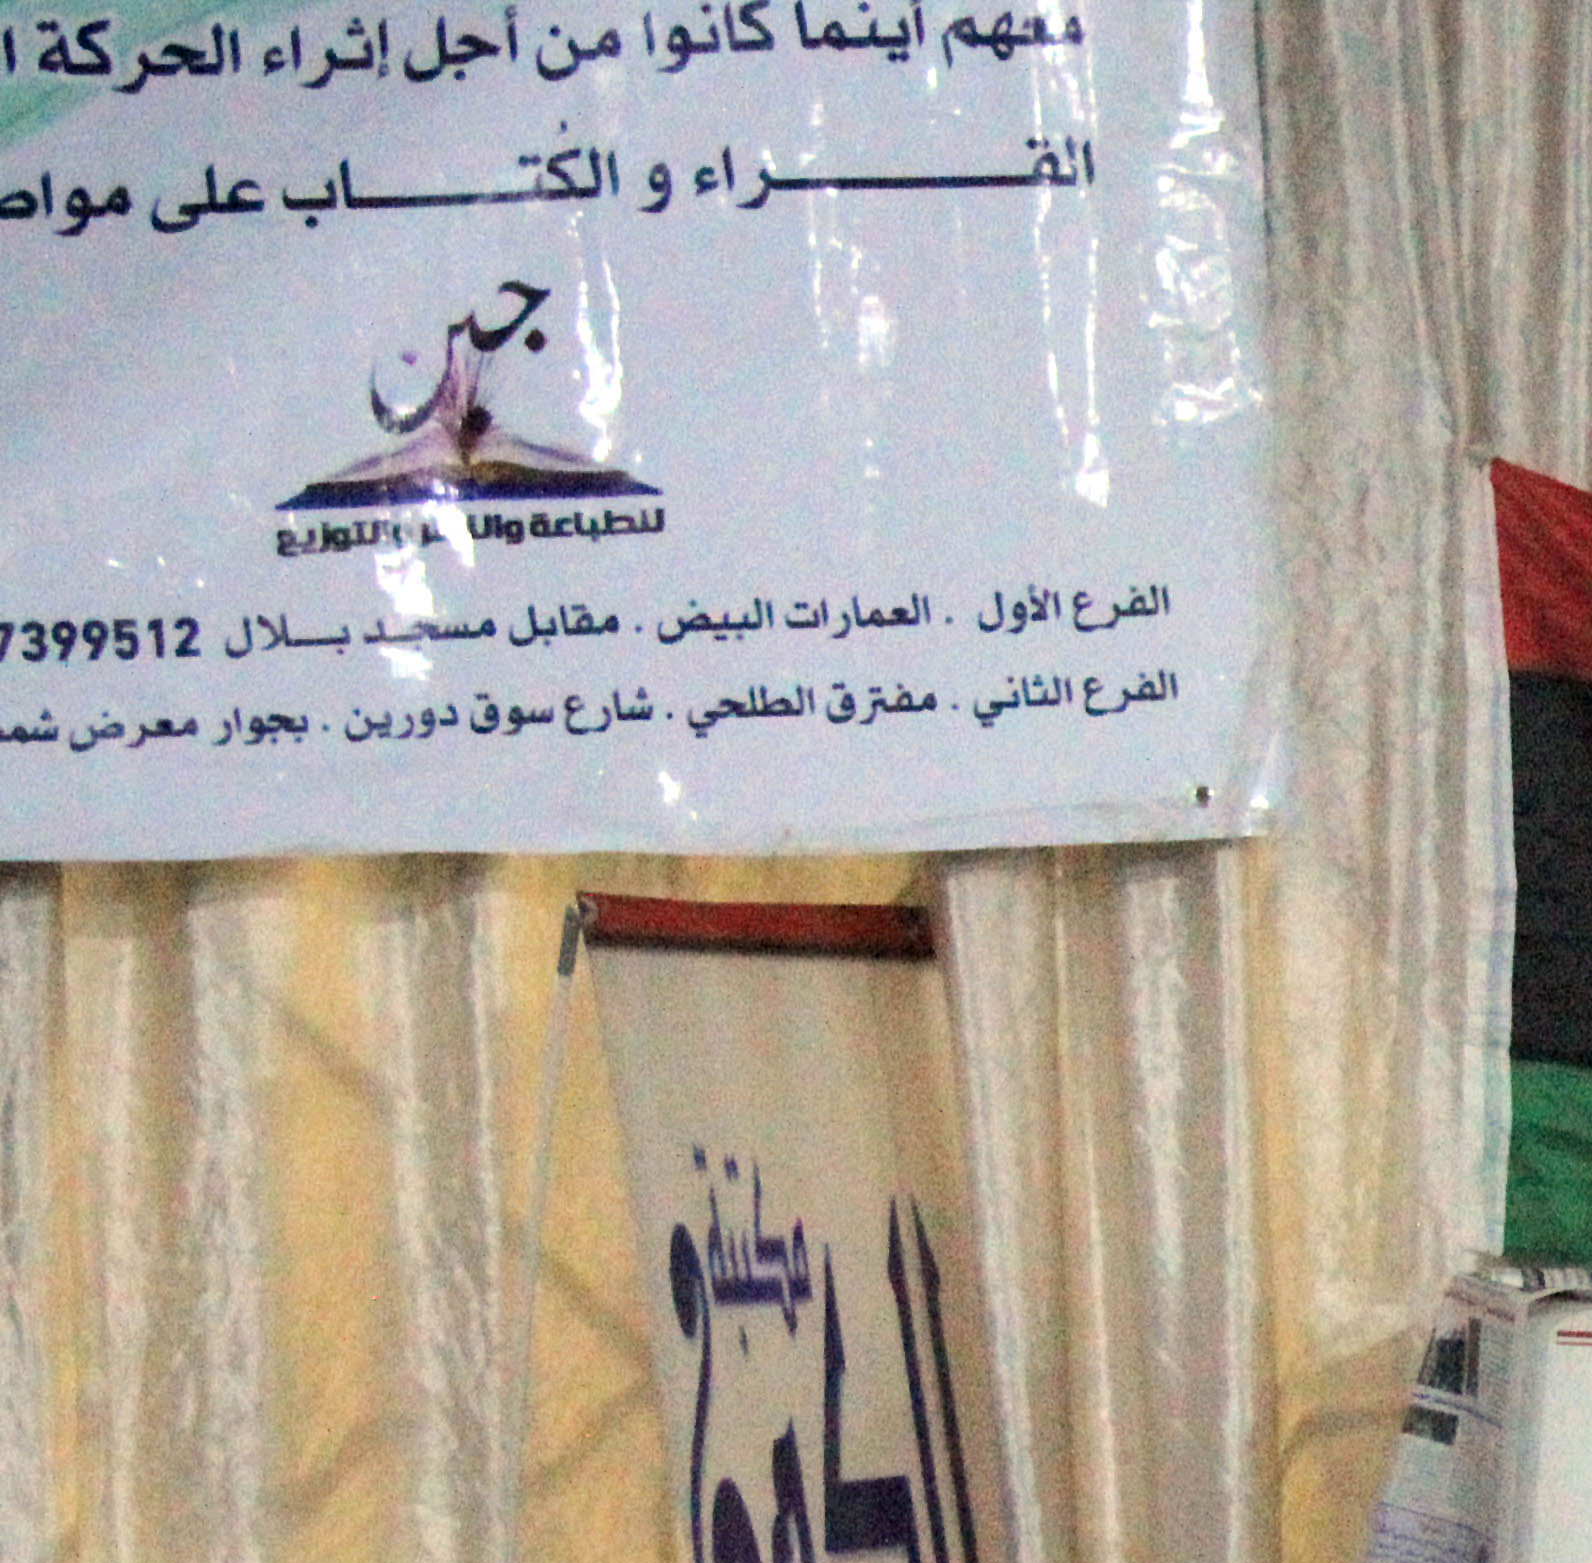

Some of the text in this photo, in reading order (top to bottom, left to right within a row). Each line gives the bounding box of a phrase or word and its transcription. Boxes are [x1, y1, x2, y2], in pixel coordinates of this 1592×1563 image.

[36, 18, 242, 94] الحركة
[263, 15, 389, 89] إثراء
[404, 4, 519, 82] أجل
[536, 24, 622, 81] من
[642, 0, 775, 74] كانوا
[150, 163, 266, 234] على
[637, 160, 673, 213] و
[530, 507, 666, 541] للطباعة
[509, 603, 622, 648] مقابل
[657, 597, 775, 645] البيض
[784, 592, 932, 640] العمارات
[976, 582, 1062, 634] الأول
[1073, 584, 1171, 632] الفرع
[469, 694, 555, 737] سوق
[564, 686, 655, 735] شارع
[825, 681, 939, 726] مفترق
[973, 674, 1074, 729] الثاني
[1084, 668, 1179, 716] الفرع
[68, 709, 200, 752] معرض
[212, 710, 310, 748] بجوار
[344, 699, 460, 744] دورين
